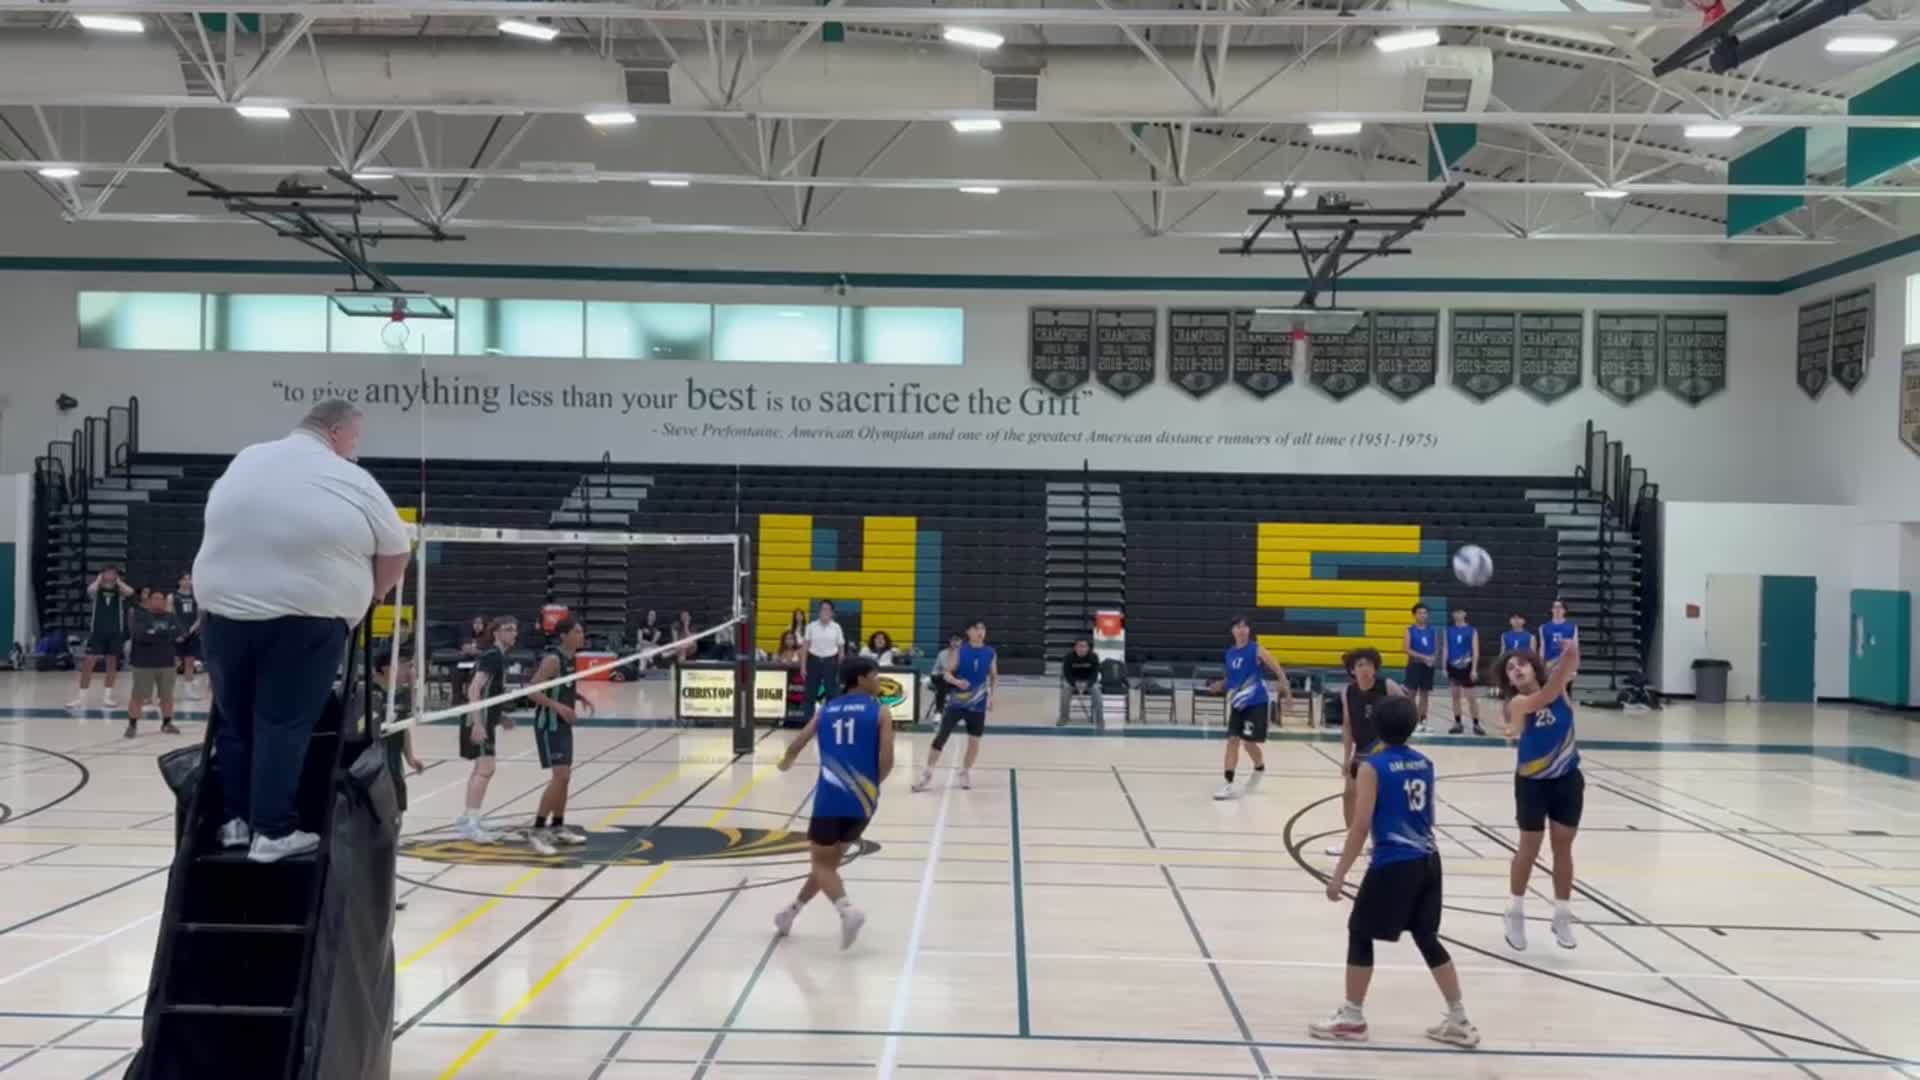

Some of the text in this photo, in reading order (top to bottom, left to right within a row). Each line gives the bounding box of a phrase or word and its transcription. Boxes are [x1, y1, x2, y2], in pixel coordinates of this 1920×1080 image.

[364, 376, 500, 414] anything
[509, 384, 554, 408] less
[562, 385, 614, 409] than
[621, 391, 679, 415] your
[686, 377, 757, 411] best
[766, 385, 784, 411] is
[790, 388, 813, 413] to
[818, 382, 961, 415] sacrifice
[967, 387, 1012, 415] the
[661, 421, 698, 437] Steve
[787, 424, 855, 440] American
[857, 425, 925, 443] Olympian
[928, 426, 955, 441] and
[984, 426, 1002, 445] of
[1003, 427, 1025, 443] the
[1026, 427, 1083, 446] greatest
[1085, 429, 1153, 445] American
[1155, 430, 1214, 445] distance
[1216, 434, 1271, 446] runners
[1274, 430, 1292, 448] of
[1292, 431, 1313, 446] all
[1314, 432, 1347, 447] time
[1349, 433, 1440, 448] (1951-1975)
[757, 514, 1422, 667] H S
[682, 687, 733, 699] CHRISTOP
[756, 687, 783, 700] HIGH
[831, 717, 855, 745] 11
[1403, 779, 1426, 811] 13
